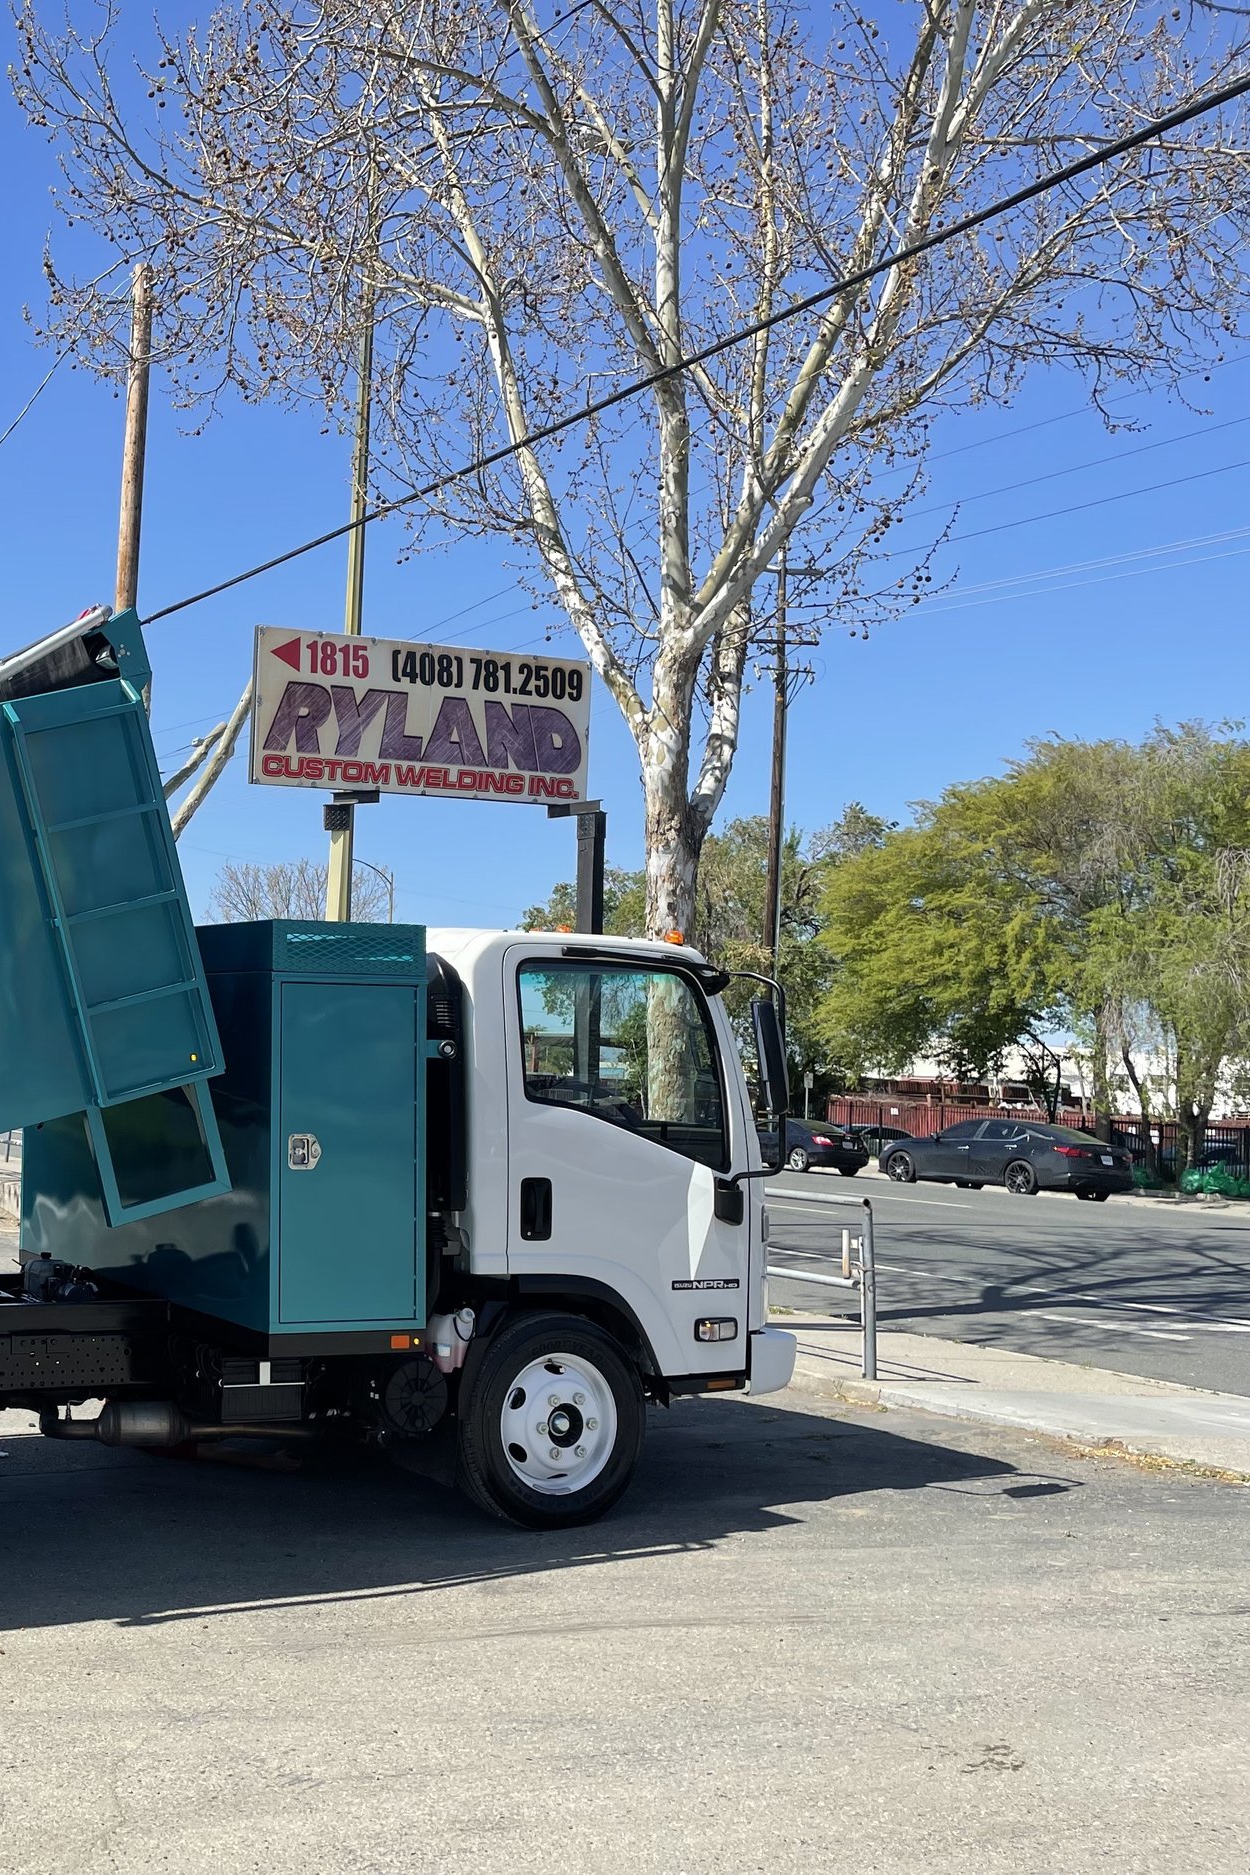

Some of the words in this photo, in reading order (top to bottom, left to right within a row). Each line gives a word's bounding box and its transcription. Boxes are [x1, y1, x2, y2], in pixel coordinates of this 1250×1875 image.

[306, 640, 370, 679] 1815
[391, 650, 463, 688] (408)
[470, 658, 583, 701] 781.2509
[262, 681, 582, 774] RYLAND
[262, 754, 392, 785] CUSTOM
[394, 764, 525, 795] WELDING
[528, 775, 580, 799] INC.
[692, 1280, 724, 1289] NPR
